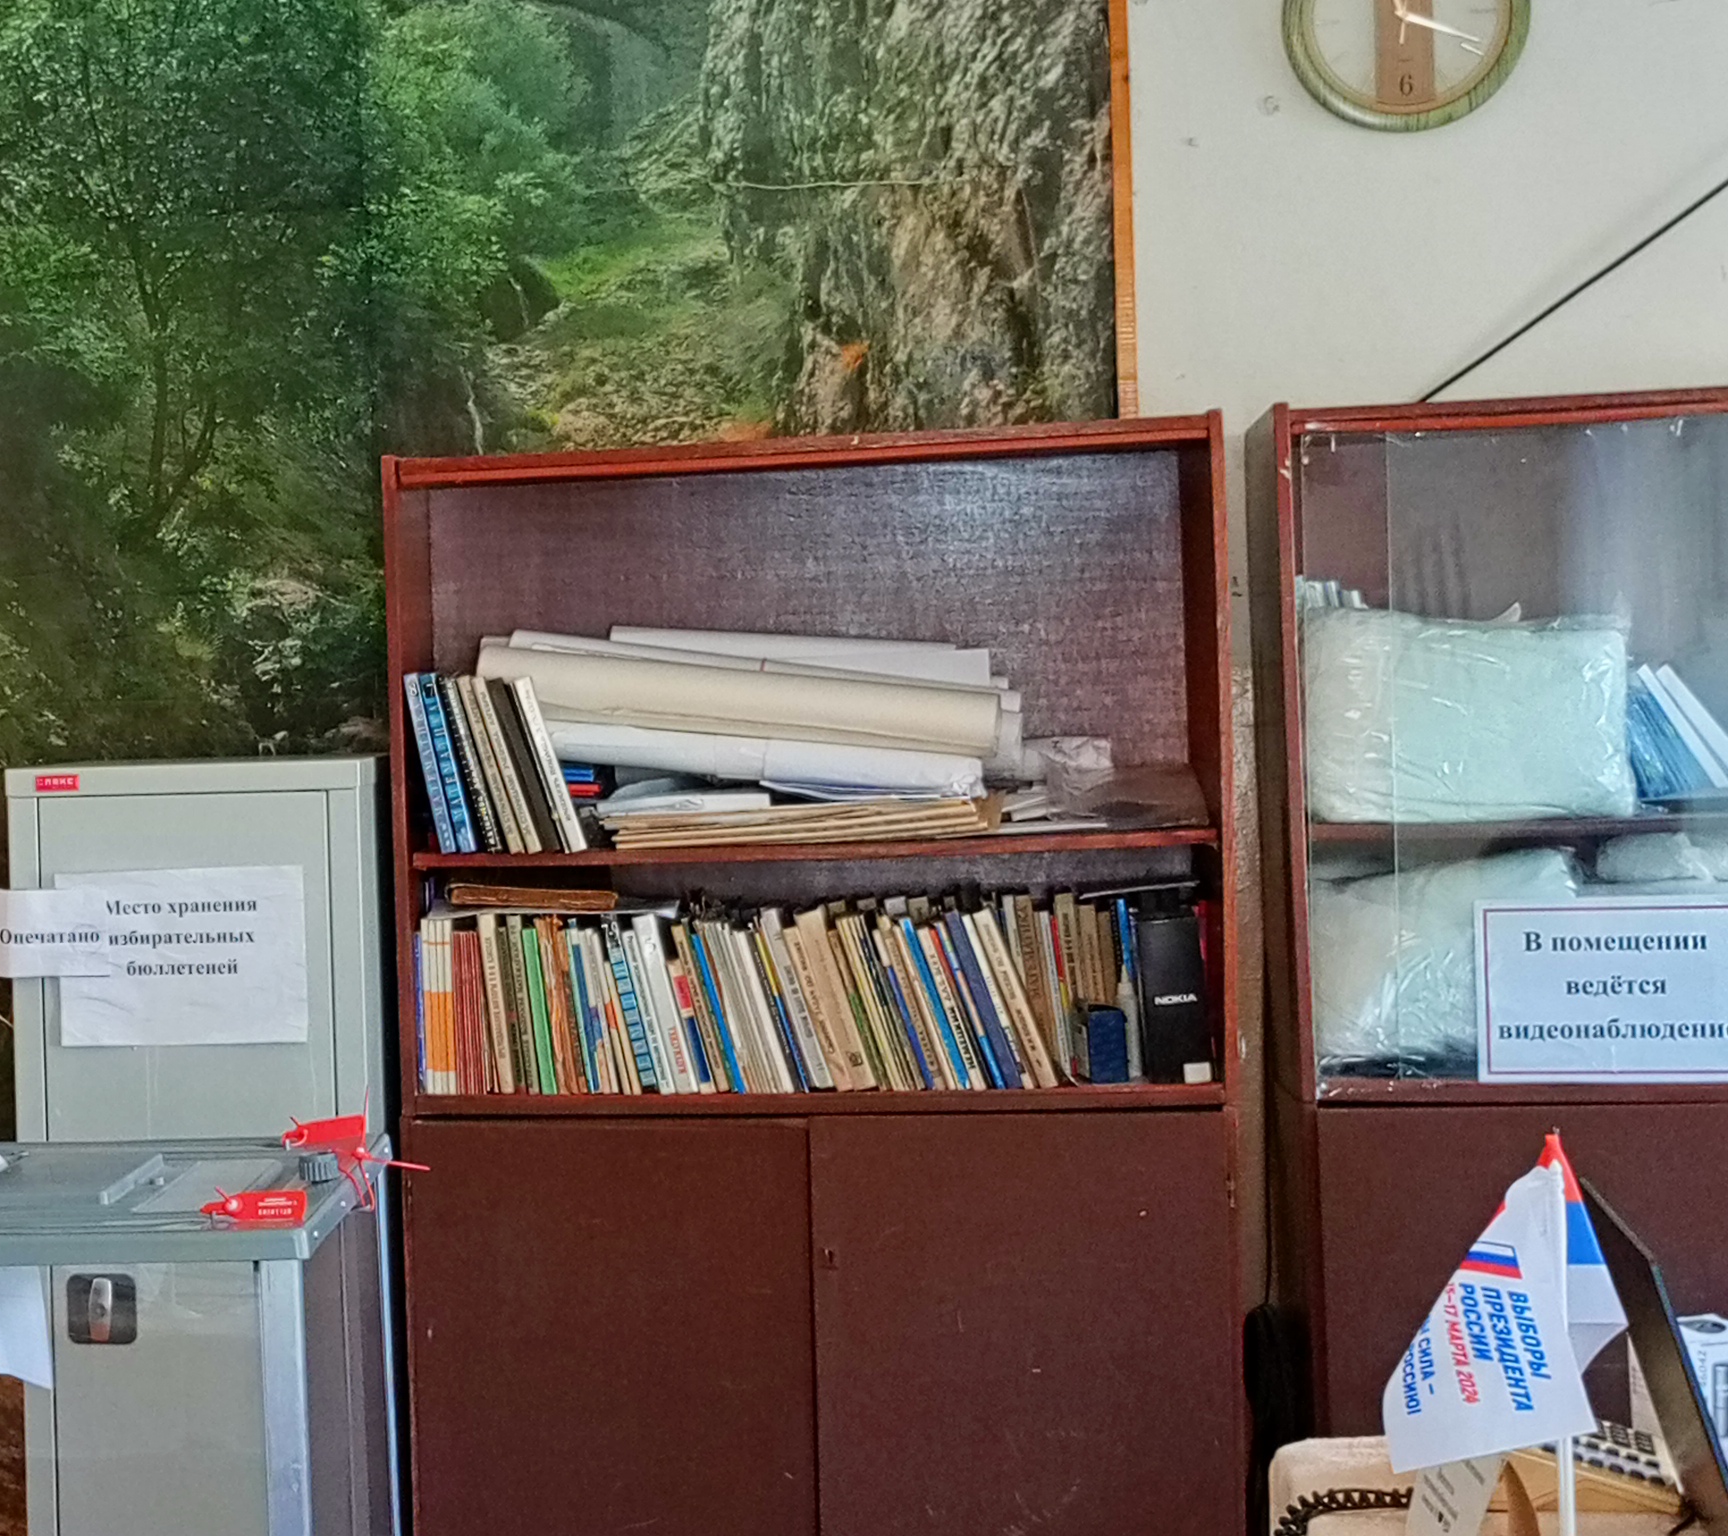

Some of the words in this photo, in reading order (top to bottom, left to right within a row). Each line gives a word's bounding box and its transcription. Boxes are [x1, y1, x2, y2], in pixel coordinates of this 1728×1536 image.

[1399, 75, 1413, 96] 6
[106, 900, 162, 915] Место
[168, 899, 258, 918] хранения
[0, 928, 100, 945] Опечатано
[108, 930, 255, 949] избирательных
[1523, 931, 1542, 952] В
[1551, 934, 1707, 953] помещении
[126, 958, 239, 976] бюллетеней
[1566, 975, 1666, 996] ведётся
[1154, 992, 1198, 1006] NOKIA
[1459, 1283, 1494, 1362] РОССИИ
[1445, 1320, 1470, 1366] МАРТА
[1507, 1290, 1552, 1380] ВЫБОРЫ
[1418, 1337, 1435, 1381] СИЛА
[1480, 1286, 1534, 1411] ПРЕЗИДЕНТА
